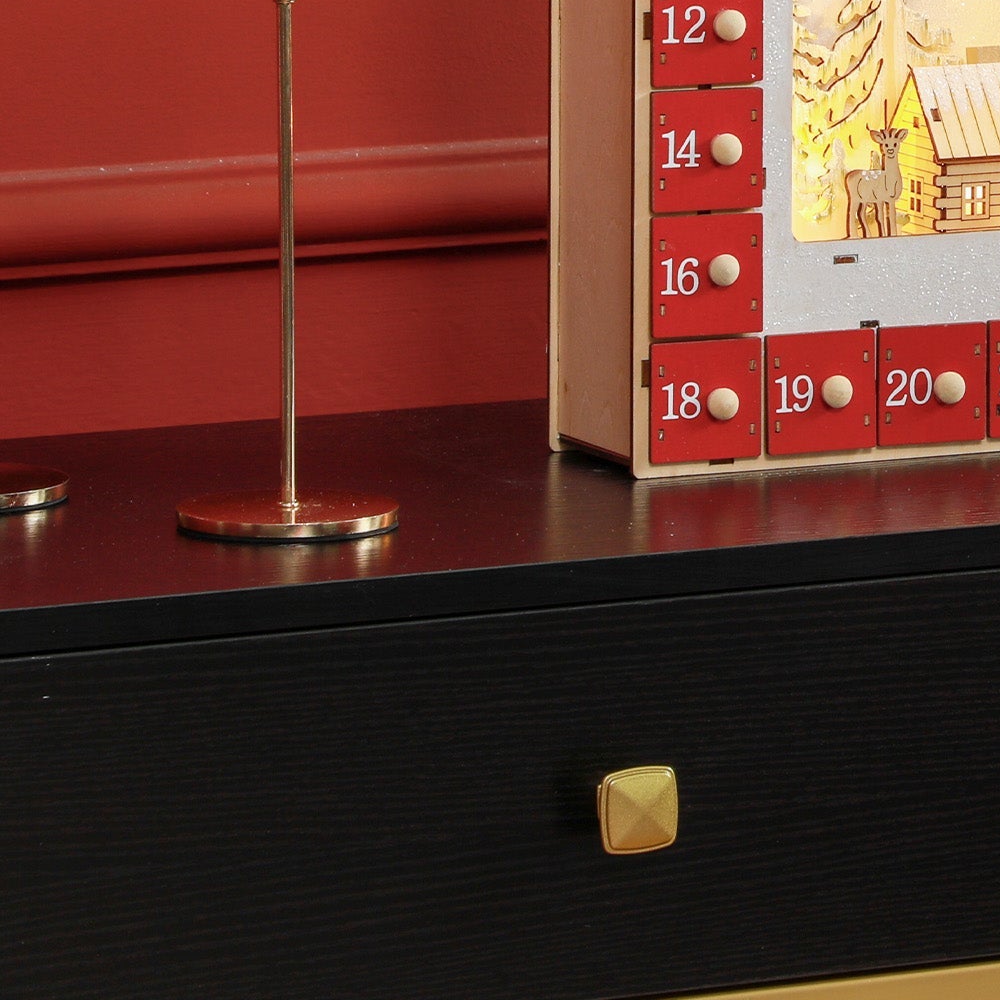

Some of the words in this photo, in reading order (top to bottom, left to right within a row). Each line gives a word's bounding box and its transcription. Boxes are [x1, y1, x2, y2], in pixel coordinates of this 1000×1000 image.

[662, 6, 705, 43] 12
[662, 130, 700, 168] 14
[661, 258, 699, 295] 16
[662, 382, 700, 420] 18
[775, 375, 813, 413] 19
[886, 368, 932, 406] 20
